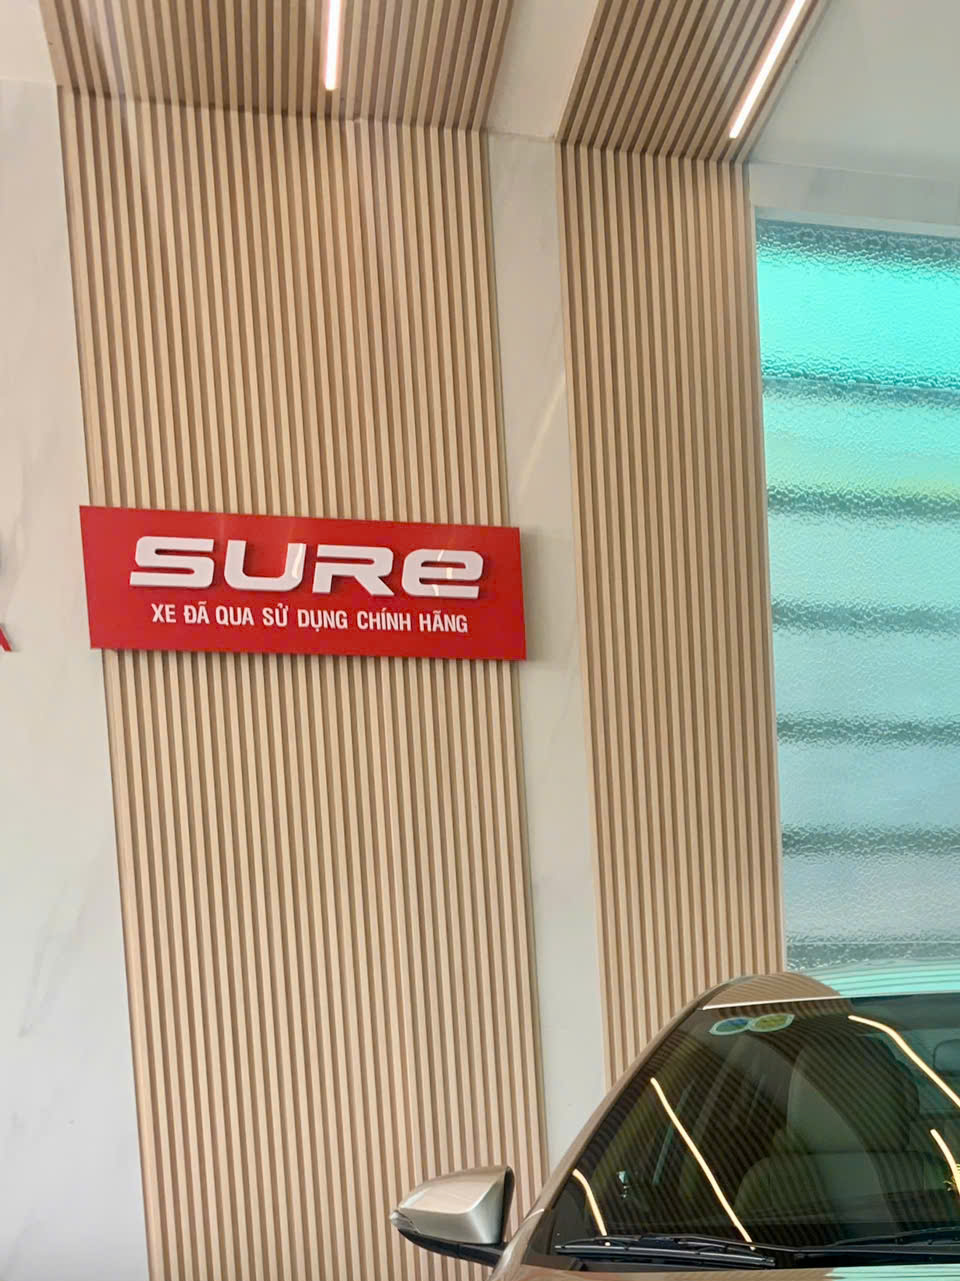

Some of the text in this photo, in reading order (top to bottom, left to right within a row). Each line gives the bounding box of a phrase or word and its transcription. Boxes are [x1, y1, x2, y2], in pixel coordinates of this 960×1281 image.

[151, 600, 468, 633] XE ĐÃ QUA SỬ DỤNG CHÍNH HÃNG
